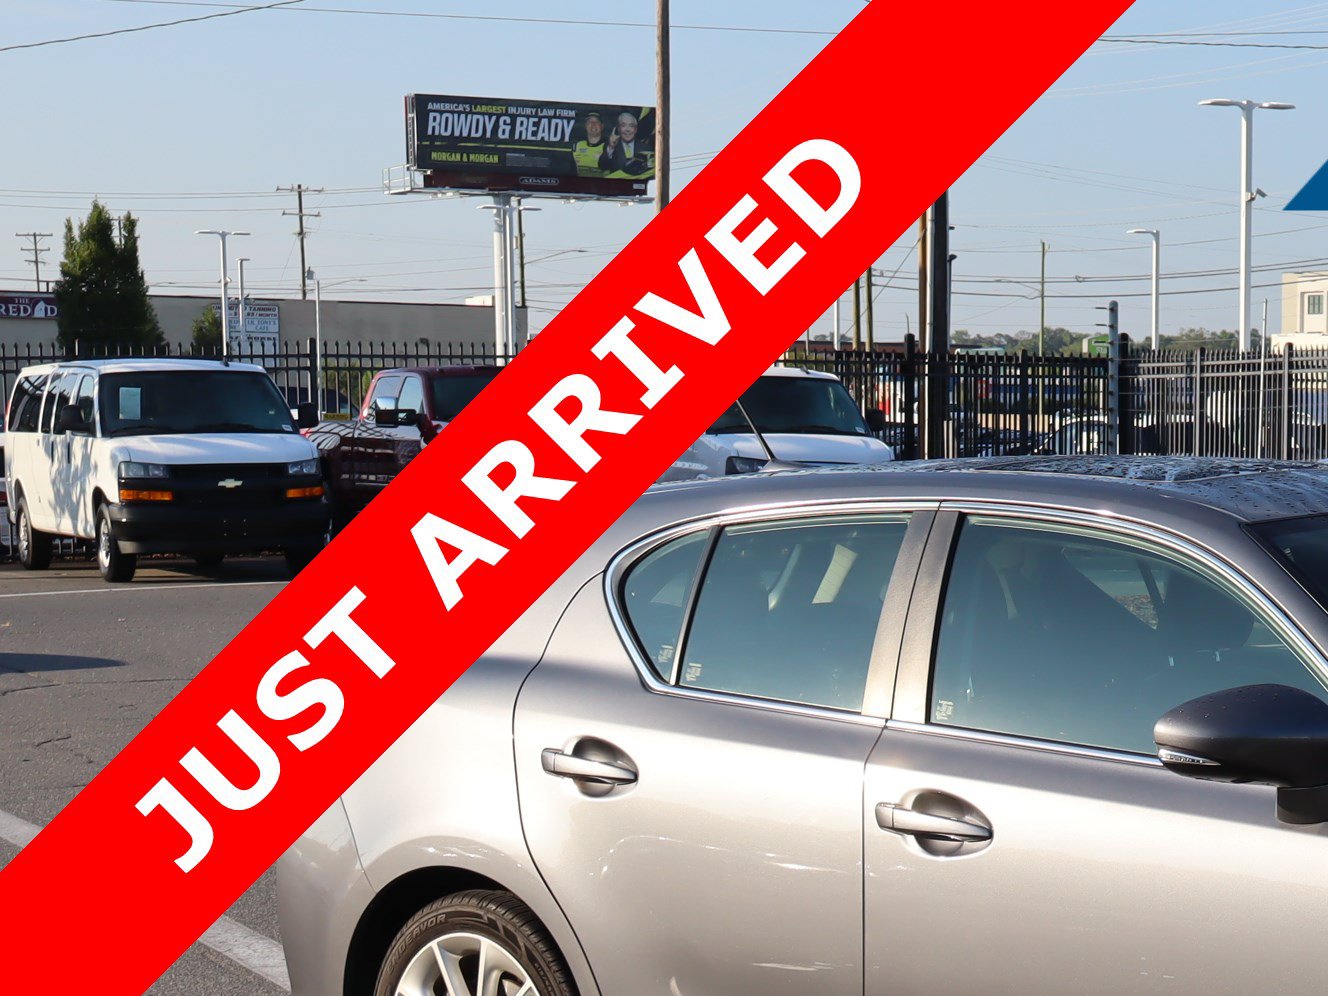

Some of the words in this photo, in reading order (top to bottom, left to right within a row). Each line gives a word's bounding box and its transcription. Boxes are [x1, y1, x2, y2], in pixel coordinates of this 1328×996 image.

[427, 102, 470, 112] AMERICA'S
[472, 105, 506, 114] LARGEST
[508, 107, 537, 115] INJURY
[538, 108, 555, 117] LAW
[556, 109, 576, 117] FIRM
[427, 112, 496, 139] ROWDY
[498, 115, 511, 139] &
[514, 117, 576, 143] READY
[431, 151, 461, 161] MORGAN
[462, 153, 468, 162] &
[469, 154, 499, 164] MORGAN
[386, 914, 446, 975] ENDEAVOR
